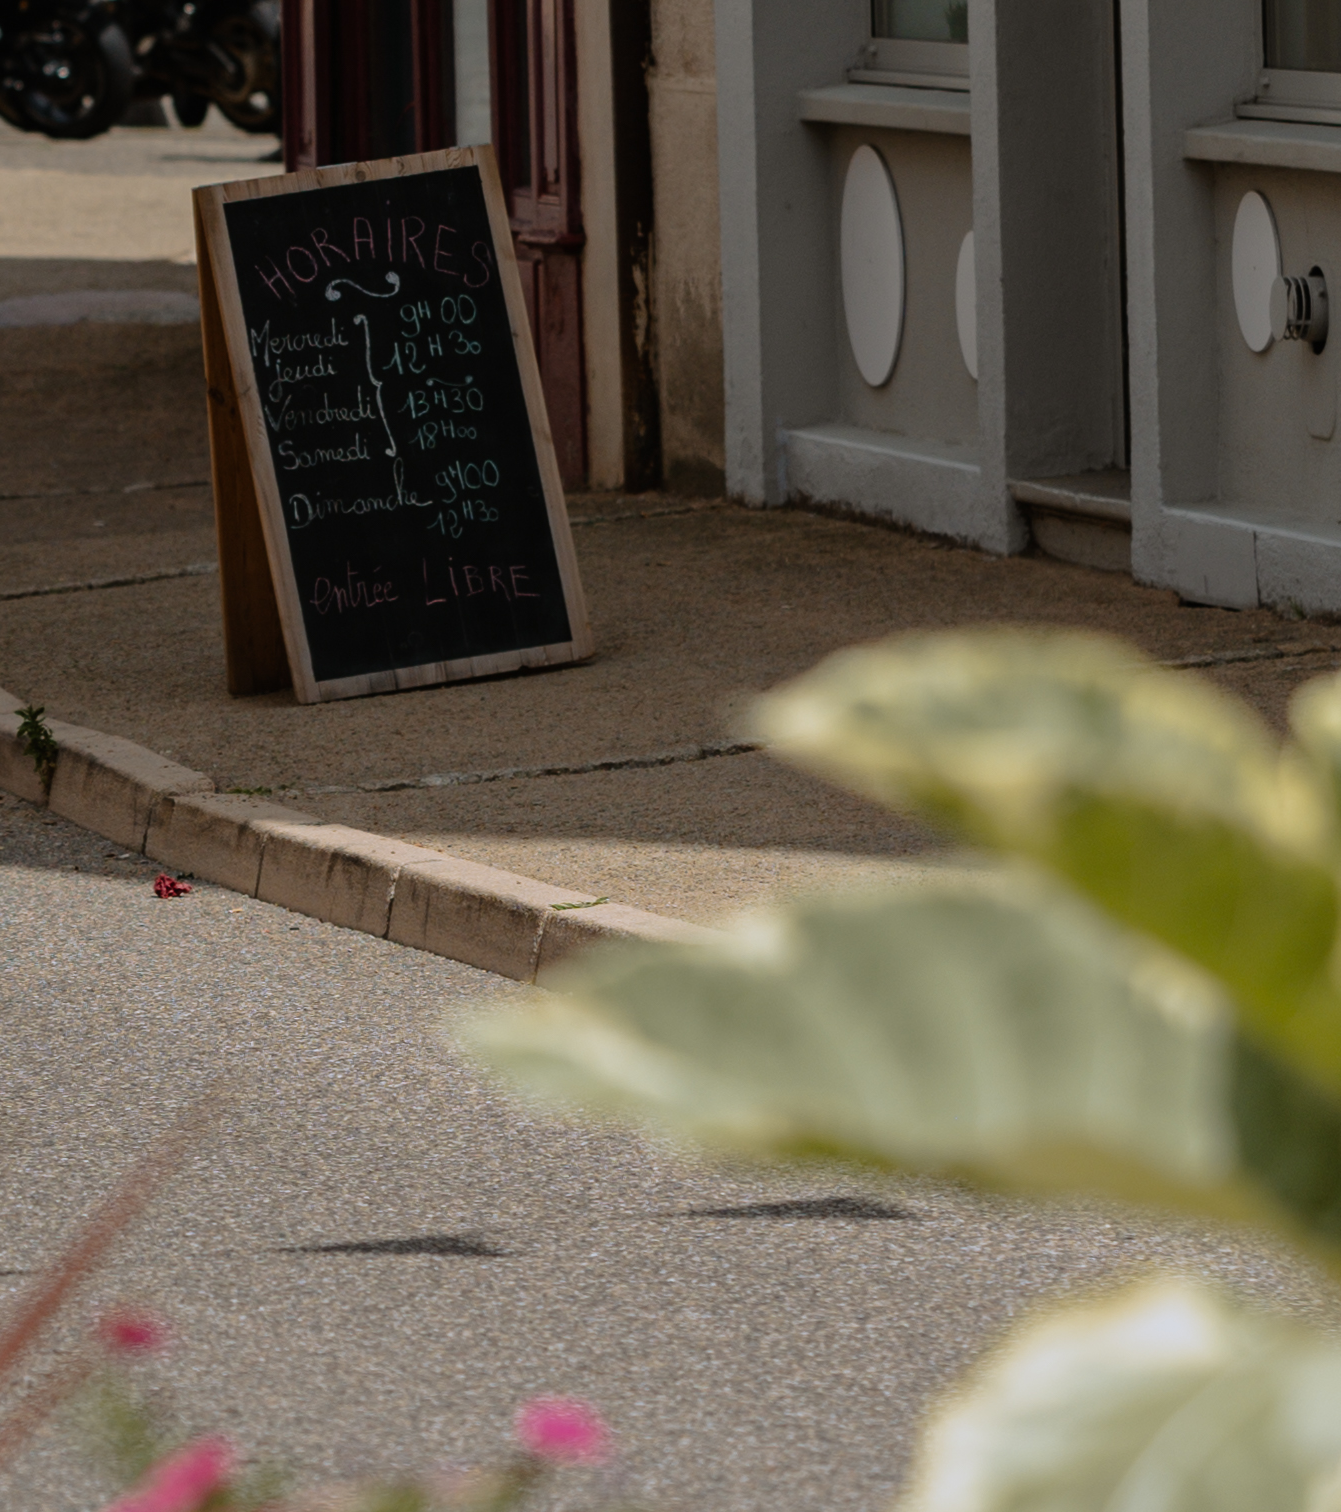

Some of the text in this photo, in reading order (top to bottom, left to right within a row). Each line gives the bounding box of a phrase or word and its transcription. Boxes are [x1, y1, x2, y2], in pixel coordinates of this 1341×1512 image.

[250, 317, 349, 367] Mercredi
[264, 384, 377, 433] Vendredi
[278, 432, 371, 471] Samedi
[289, 458, 434, 531] Dimanche
